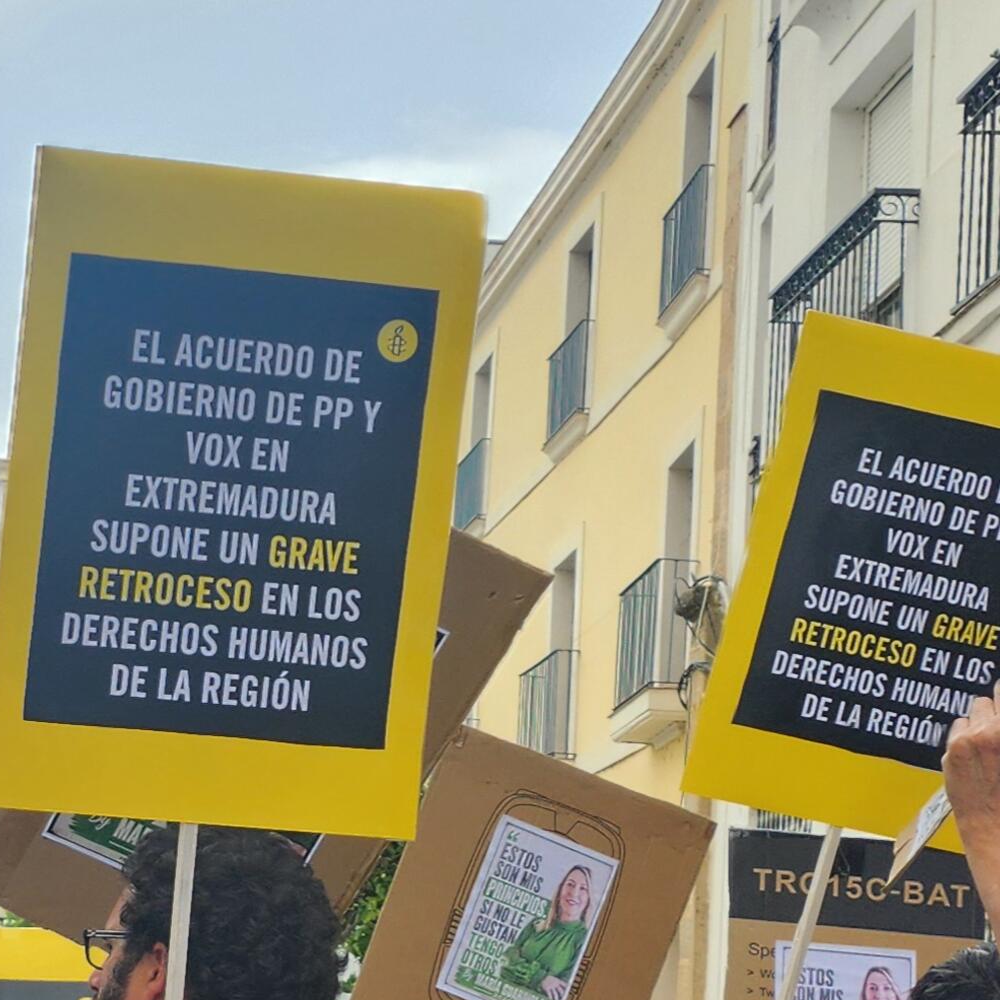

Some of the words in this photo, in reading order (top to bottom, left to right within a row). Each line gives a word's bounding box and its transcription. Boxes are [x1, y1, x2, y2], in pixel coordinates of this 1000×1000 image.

[132, 328, 166, 365] EL
[175, 333, 314, 379] ACUERDO
[324, 348, 363, 384] DE
[103, 375, 256, 422] GOBIERNO
[266, 392, 302, 427] DE
[313, 395, 353, 430] PP
[364, 400, 382, 433] Y
[186, 431, 241, 469] VOX
[251, 437, 290, 473] EN
[857, 447, 883, 477] EL
[888, 454, 992, 500] ACUERDO
[124, 473, 337, 526] EXTREMADURA
[831, 480, 946, 527] GOBIERNO
[948, 505, 980, 535] DE
[982, 513, 1000, 541] P
[90, 518, 208, 562] SUPONE
[218, 530, 260, 566] UN
[268, 535, 361, 575] GRAVE
[886, 527, 930, 560] VOX
[933, 538, 964, 569] EN
[78, 565, 253, 613] RETROCESO
[260, 582, 300, 618] EN
[307, 587, 361, 623] LOS
[835, 553, 990, 612] EXTREMADURA
[61, 611, 219, 658] DERECHOS
[228, 626, 369, 671] HUMANOS
[804, 584, 890, 626] SUPONE
[897, 607, 930, 635] UN
[931, 613, 1000, 651] GRAVE
[789, 618, 918, 668] RETROCESO
[920, 647, 951, 675] EN
[953, 654, 996, 685] LOS
[110, 663, 146, 699] DE
[157, 667, 191, 702] LA
[201, 670, 312, 712] REGIÓN
[771, 650, 889, 698] DERECHOS
[890, 676, 971, 718] HUMAN
[801, 693, 829, 722] DE
[835, 701, 861, 729] LA
[866, 710, 946, 747] REGIÓN
[494, 861, 520, 883] SON
[520, 871, 544, 893] MIS
[500, 843, 543, 873] ESTOS
[473, 915, 518, 943] GUSTAN
[480, 900, 490, 915] SI
[494, 903, 510, 922] NO
[510, 911, 526, 929] LE
[468, 931, 504, 958] TENGO
[800, 967, 834, 987] STOS
